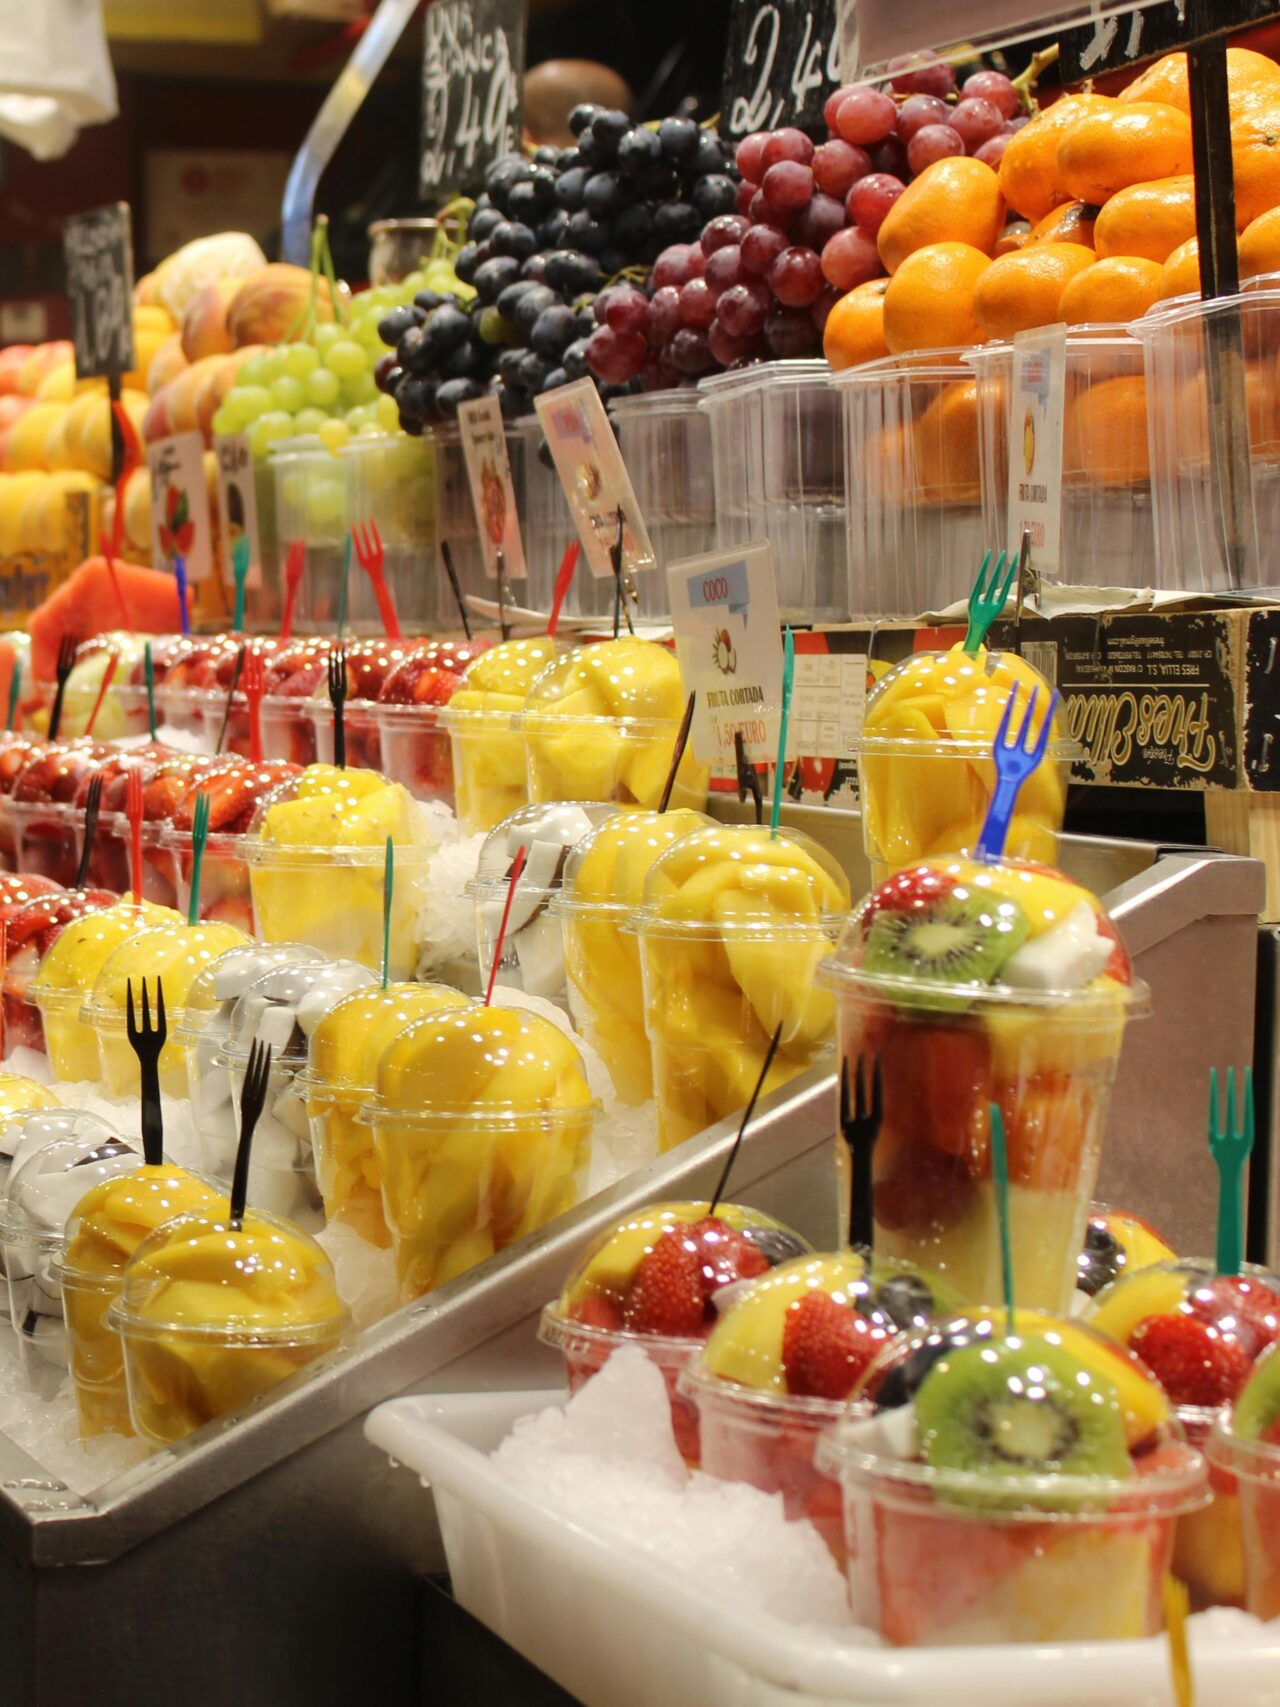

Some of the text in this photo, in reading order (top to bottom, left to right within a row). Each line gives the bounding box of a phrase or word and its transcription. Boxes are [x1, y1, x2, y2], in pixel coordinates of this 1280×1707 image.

[702, 577, 729, 601] COCO
[1181, 664, 1200, 675] FRES
[729, 685, 765, 706] CORTADA
